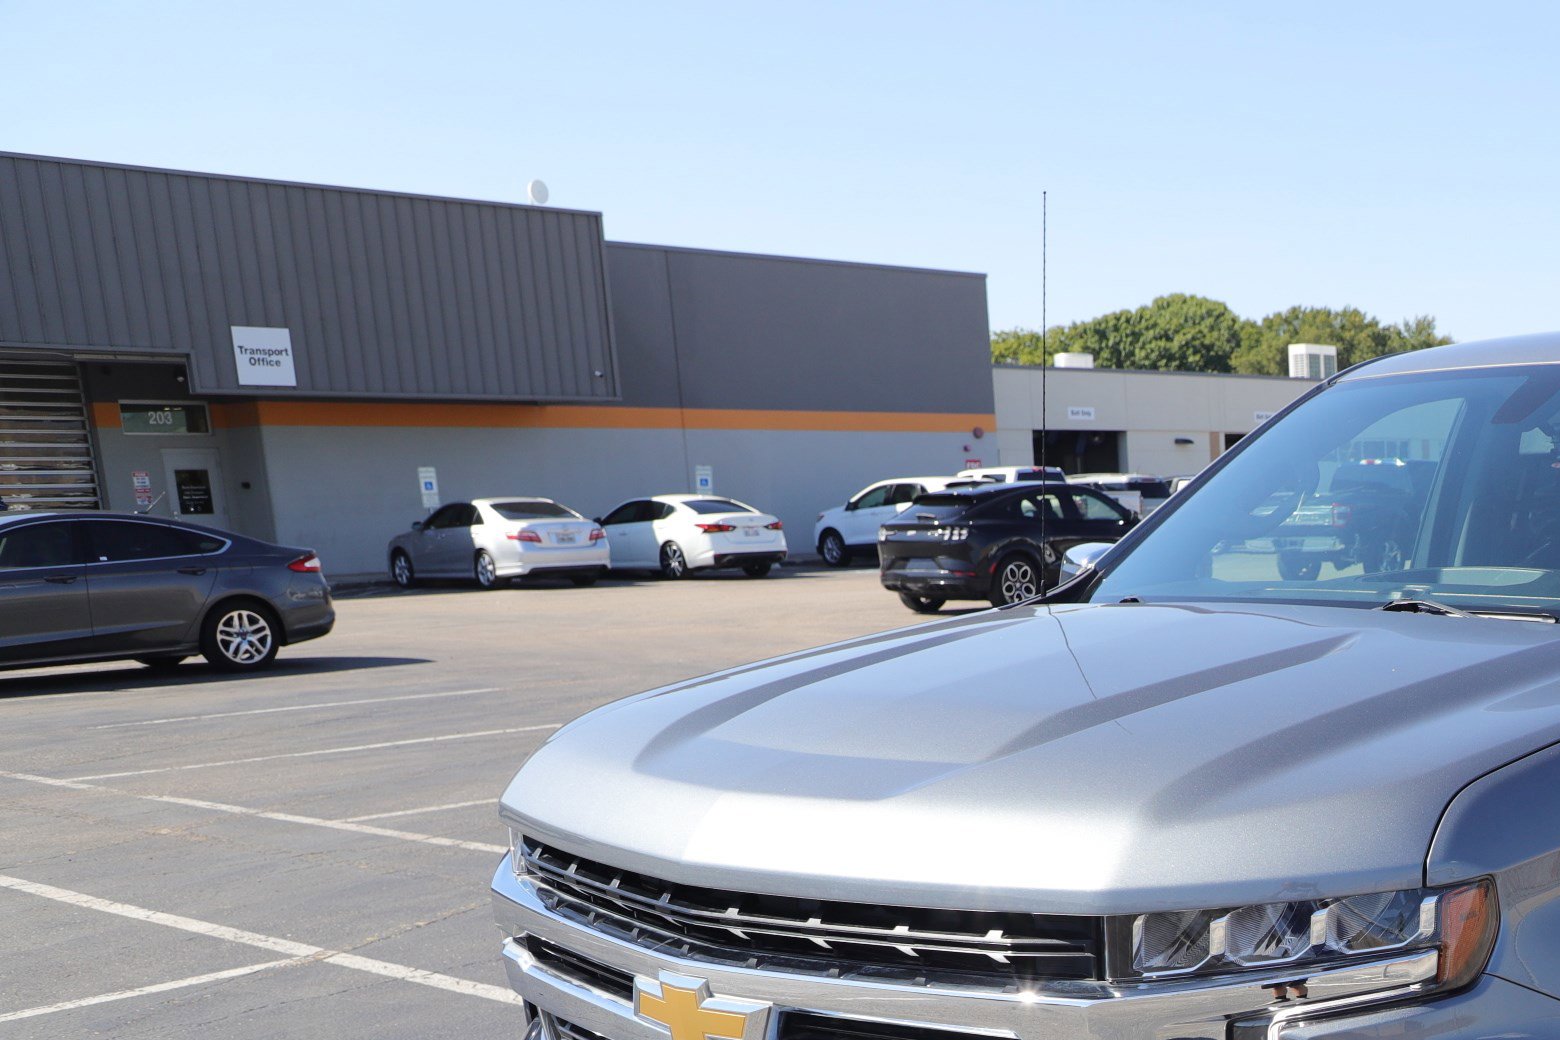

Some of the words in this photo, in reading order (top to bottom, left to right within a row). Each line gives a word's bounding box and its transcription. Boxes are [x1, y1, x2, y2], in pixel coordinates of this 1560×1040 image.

[237, 345, 289, 357] Transport
[249, 356, 281, 367] Office
[148, 411, 172, 425] 203
